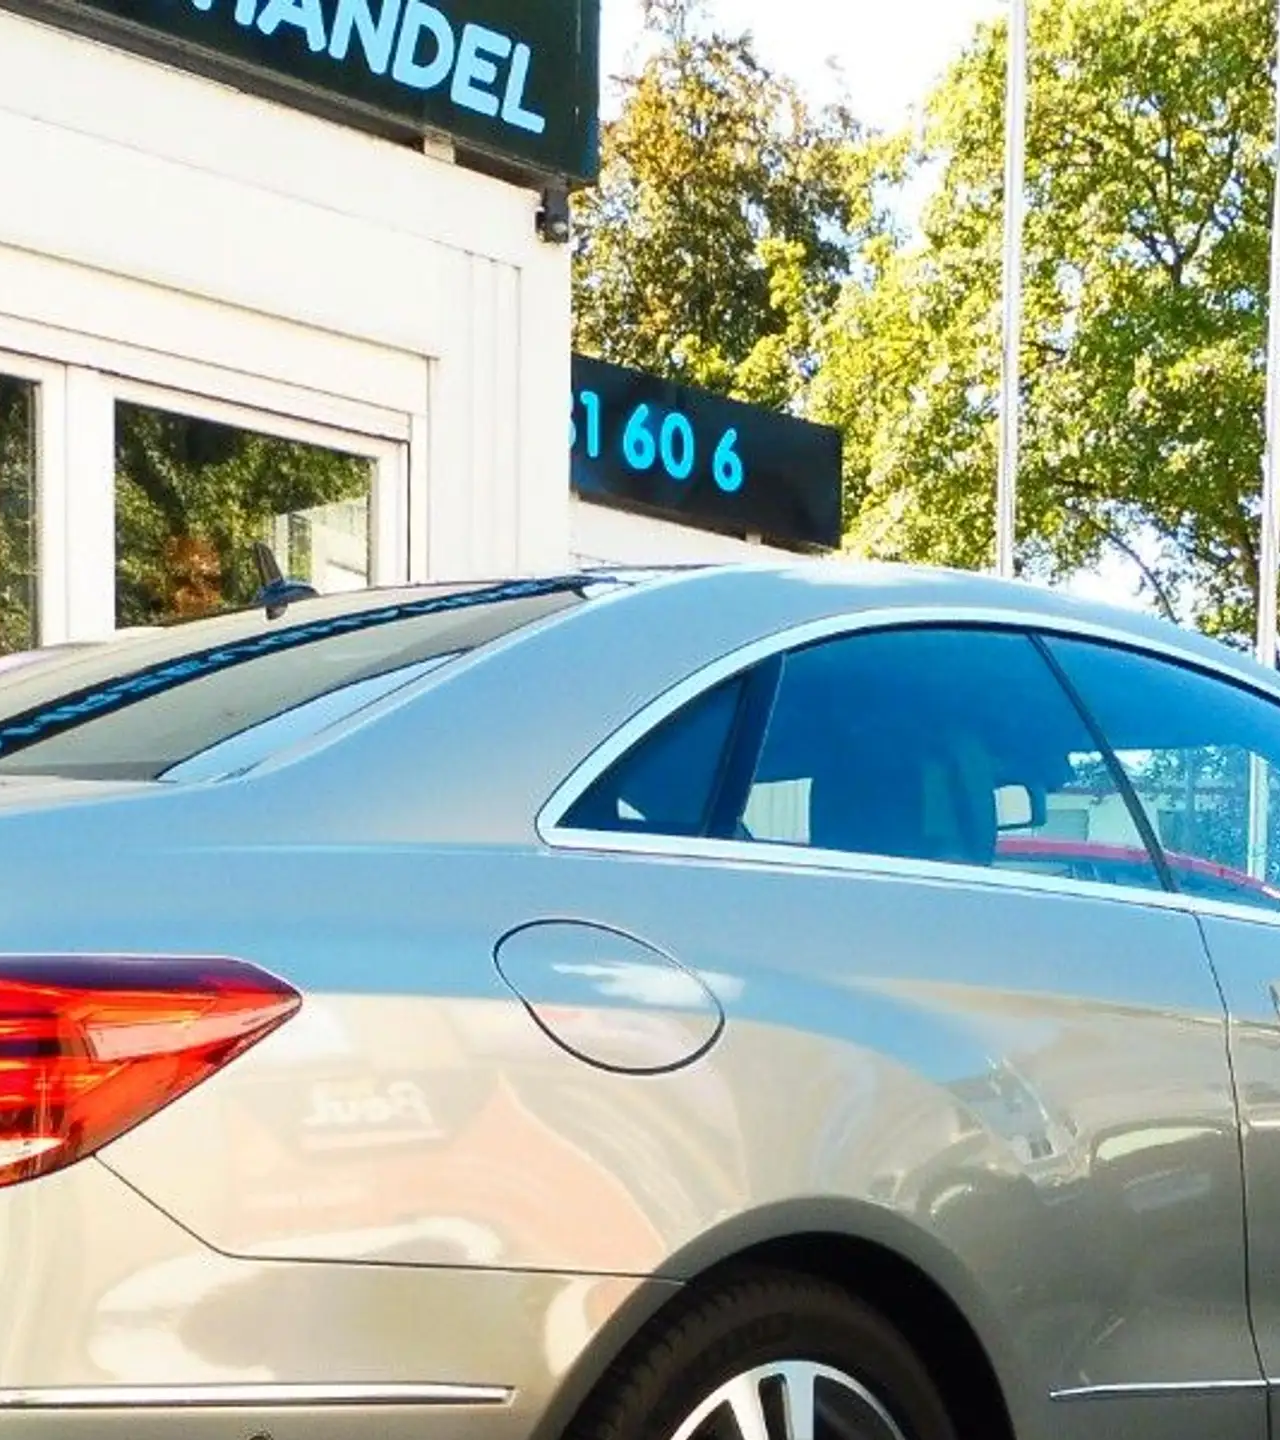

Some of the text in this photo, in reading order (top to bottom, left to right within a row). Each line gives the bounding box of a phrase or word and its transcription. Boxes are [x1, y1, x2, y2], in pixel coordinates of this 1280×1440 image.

[193, 0, 546, 134] ANDEL
[622, 403, 695, 480] 60
[712, 427, 744, 493] 6
